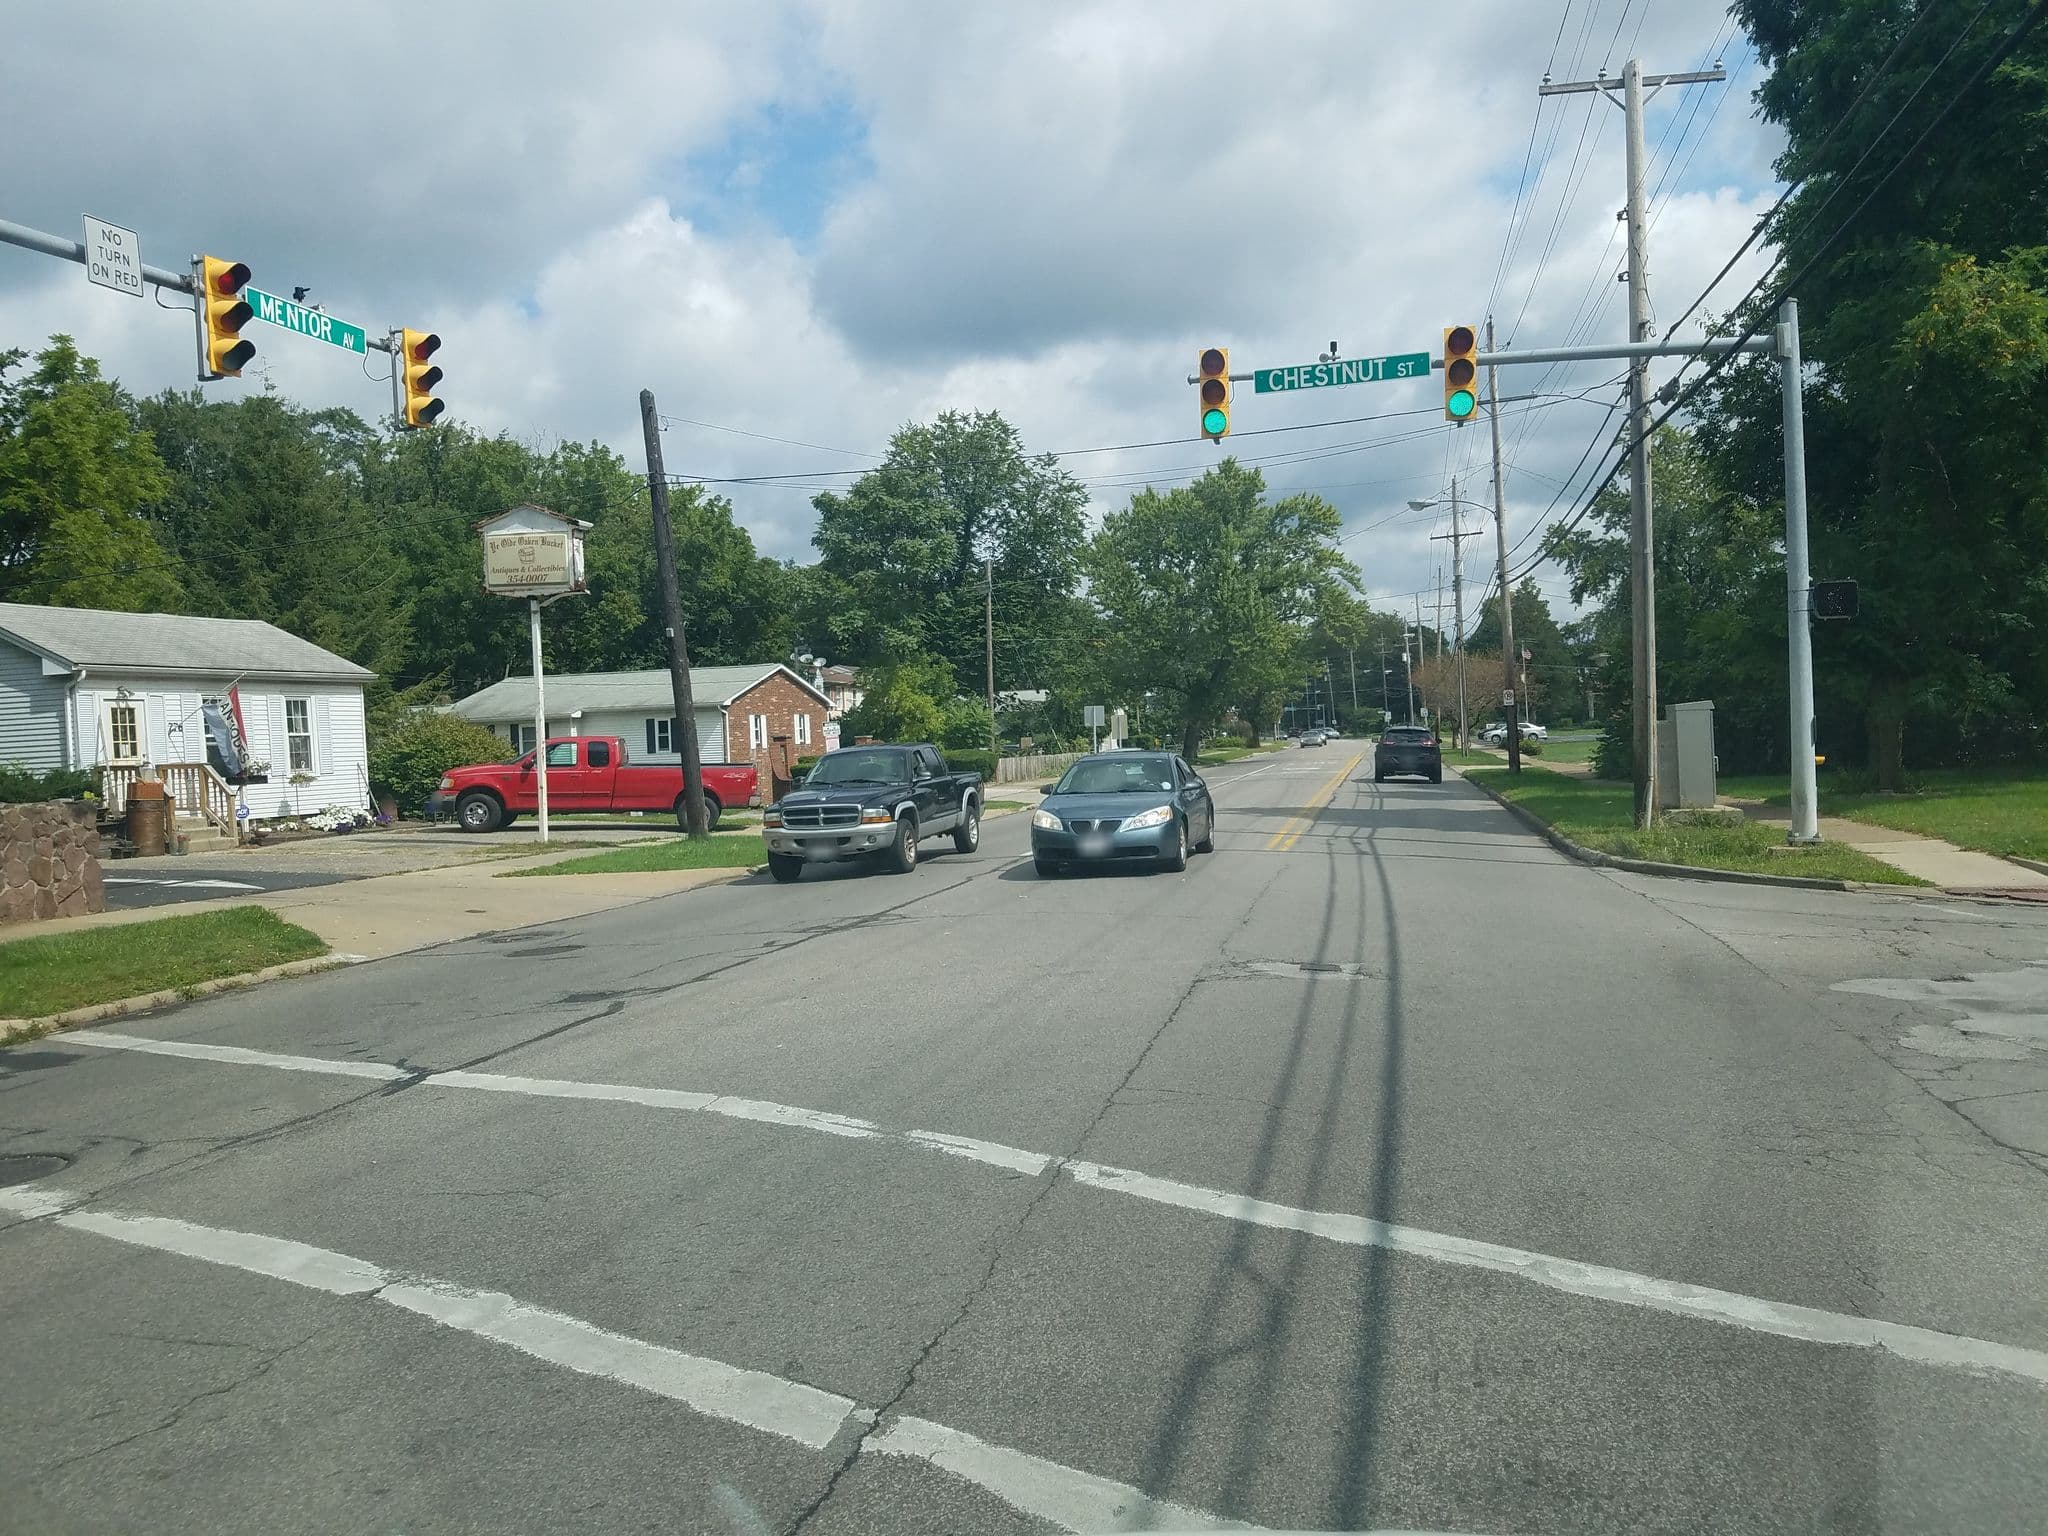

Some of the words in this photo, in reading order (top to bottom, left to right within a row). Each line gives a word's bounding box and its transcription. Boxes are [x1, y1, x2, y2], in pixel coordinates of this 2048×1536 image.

[101, 228, 122, 246] NO
[97, 245, 131, 267] TURN
[92, 262, 110, 279] ON
[114, 269, 139, 287] RED
[259, 294, 332, 342] MENTOR
[342, 331, 355, 349] AV
[1268, 358, 1387, 391] CHESTNUT
[1396, 361, 1415, 377] ST
[517, 536, 539, 546] Oaken
[540, 535, 564, 549] Bucket
[492, 566, 520, 575] Antiques
[527, 564, 566, 573] Collectibles
